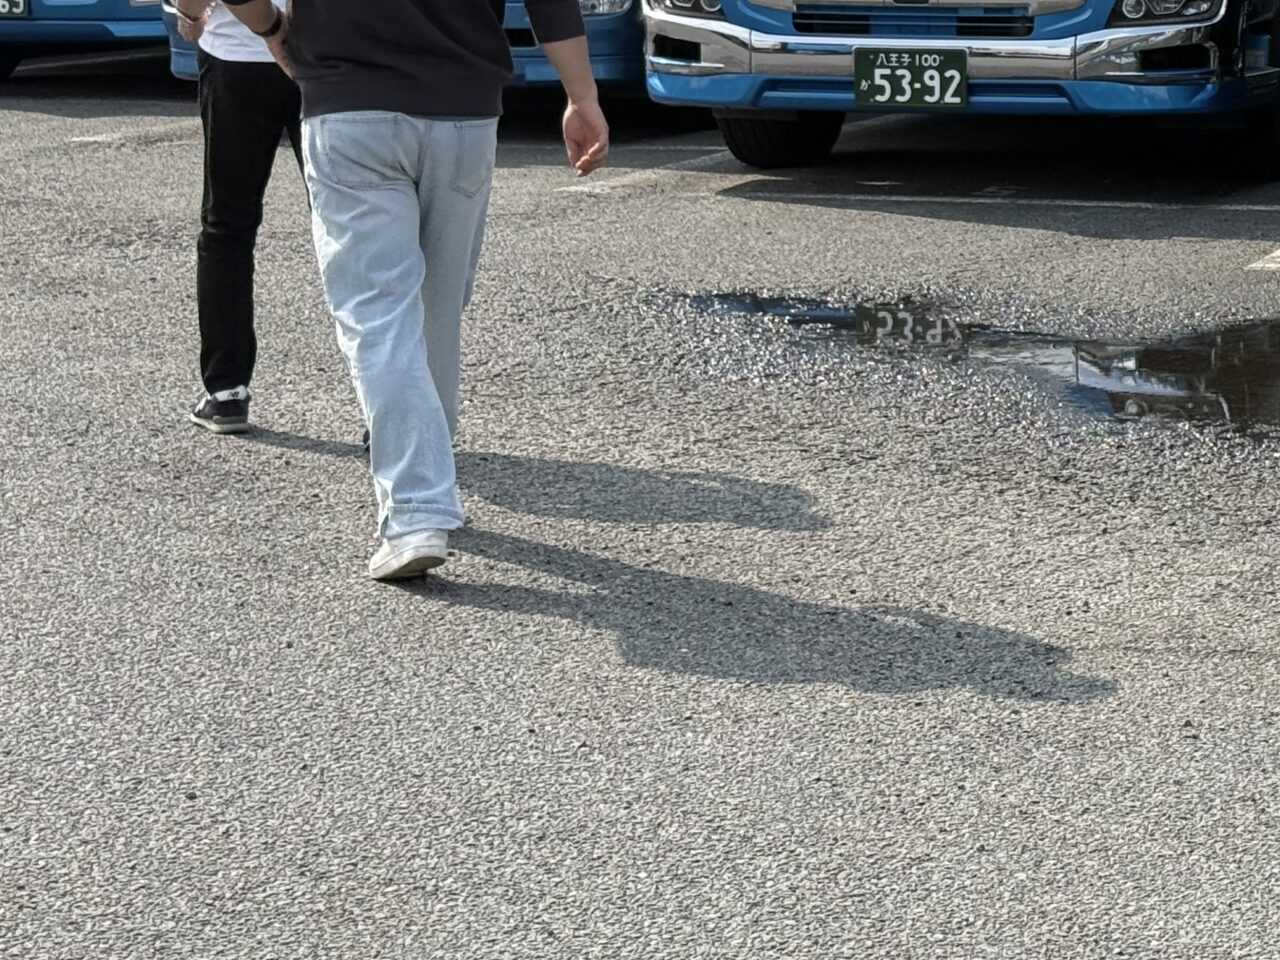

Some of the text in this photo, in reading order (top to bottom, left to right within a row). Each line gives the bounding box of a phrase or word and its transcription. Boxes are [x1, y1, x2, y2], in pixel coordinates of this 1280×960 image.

[876, 53, 941, 67] 八王子 100
[874, 68, 962, 104] 53-92
